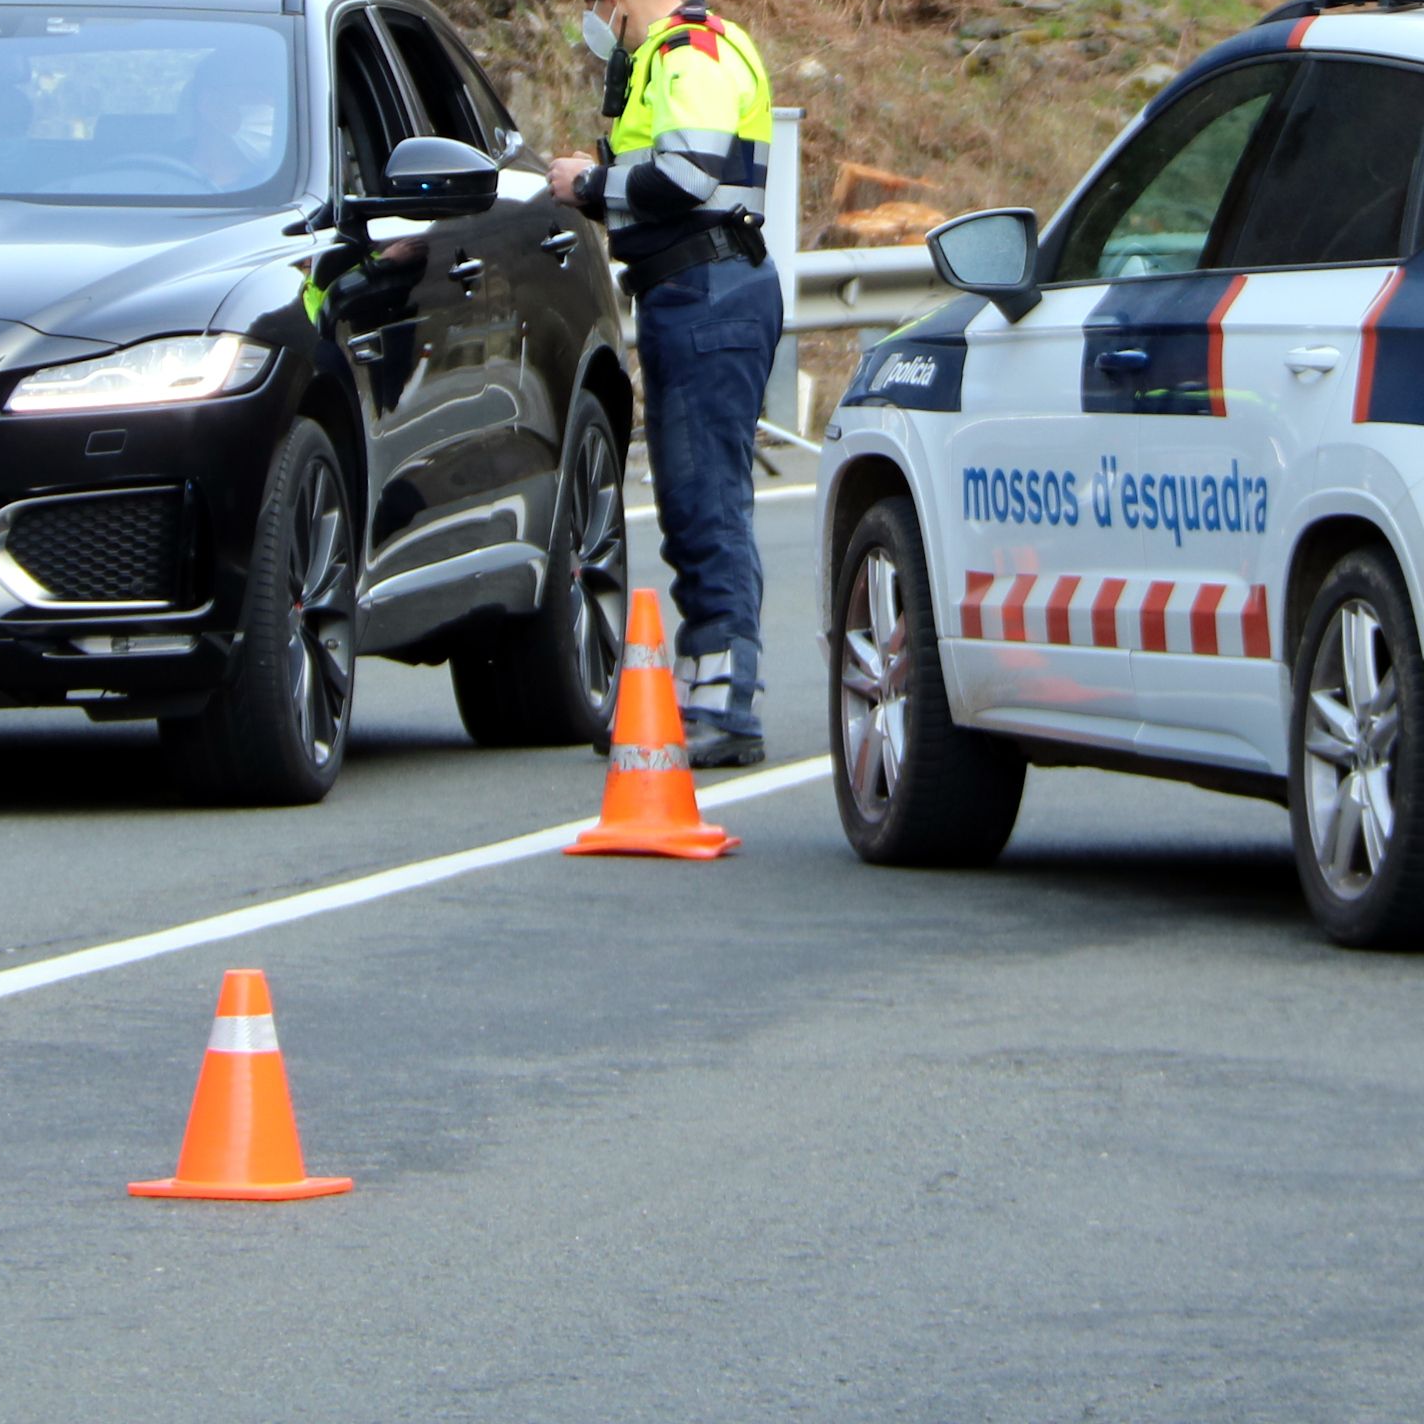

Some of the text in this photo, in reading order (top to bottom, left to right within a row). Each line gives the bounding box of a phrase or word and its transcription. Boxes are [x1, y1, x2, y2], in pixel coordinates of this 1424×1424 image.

[883, 356, 936, 389] policia
[963, 455, 1268, 548] mossos d'esquadra
